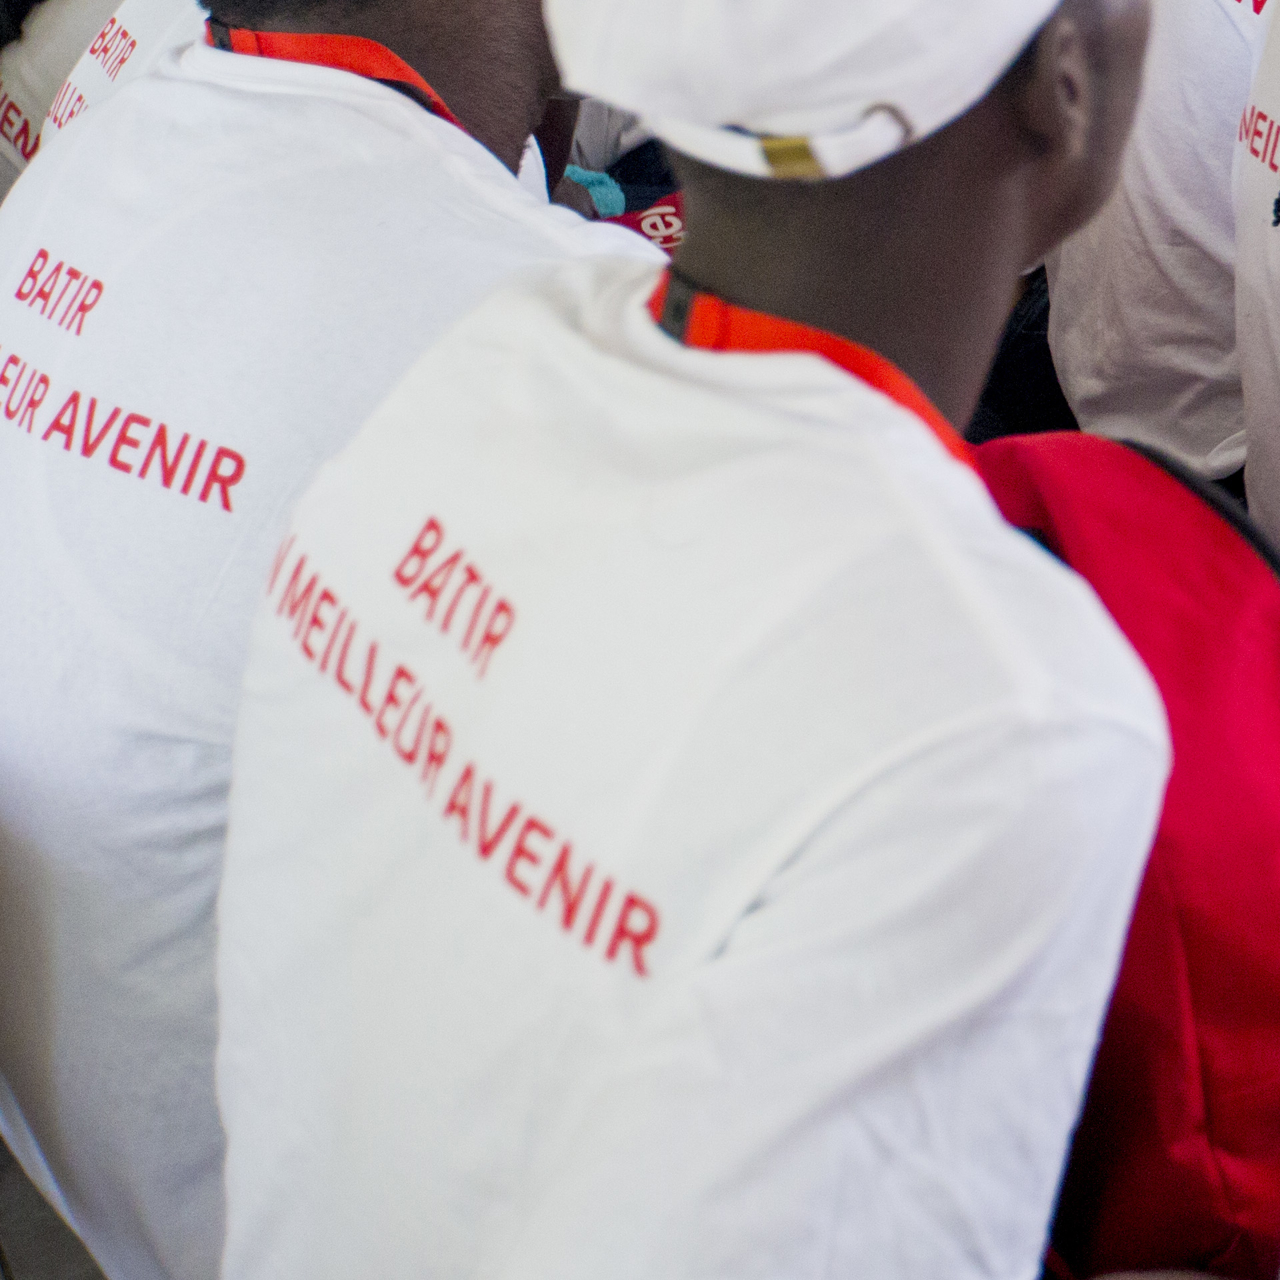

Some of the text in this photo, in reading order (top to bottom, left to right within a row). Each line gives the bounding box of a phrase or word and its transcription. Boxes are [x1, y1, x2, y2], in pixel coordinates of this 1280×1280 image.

[89, 17, 137, 82] BATIR
[15, 248, 104, 336] BATIR
[0, 352, 246, 513] EUR AVENIR
[392, 515, 517, 681] BATIR
[276, 553, 660, 980] MEILLEUR AVENIR
